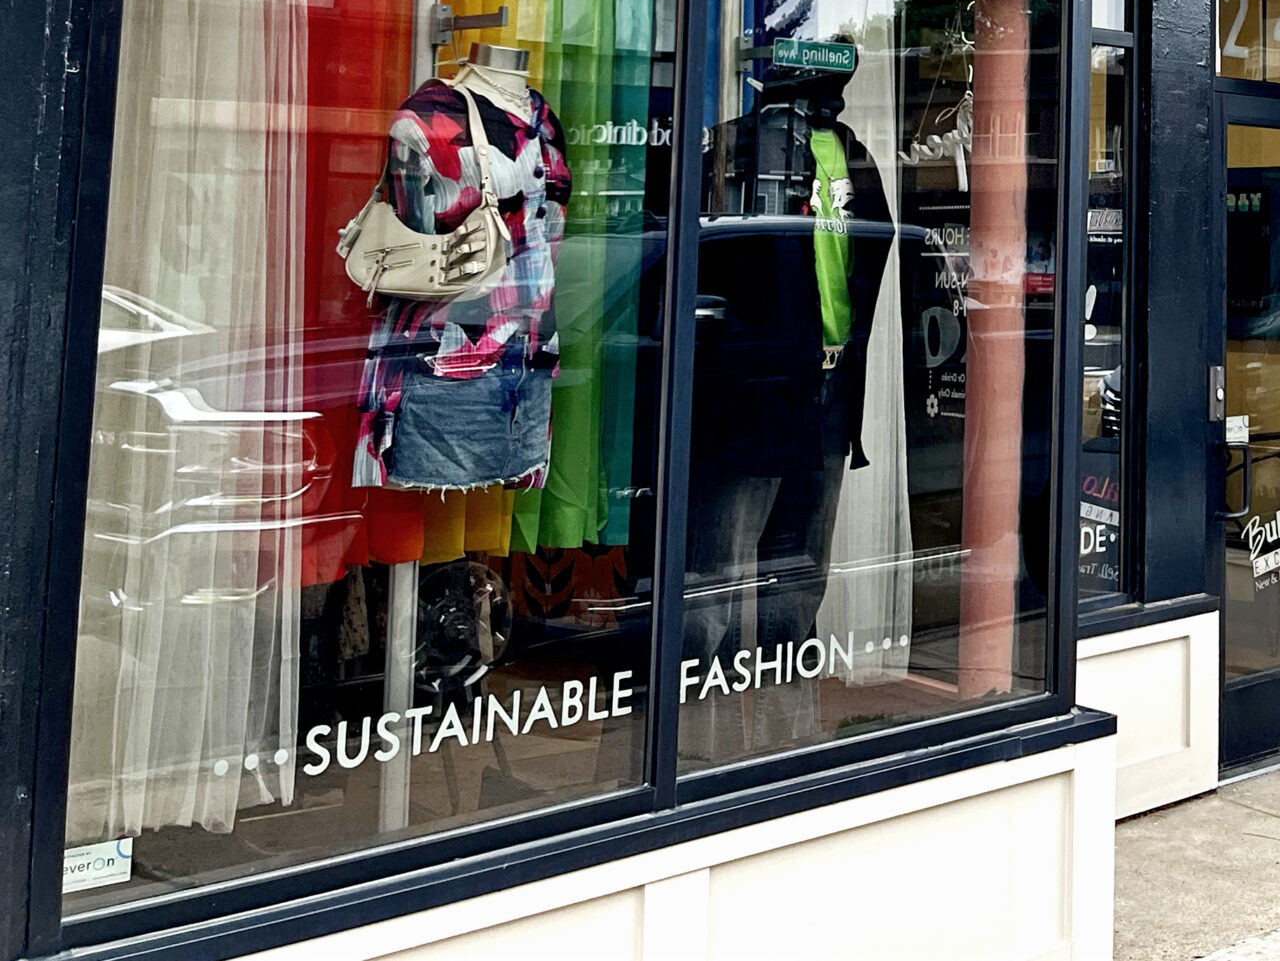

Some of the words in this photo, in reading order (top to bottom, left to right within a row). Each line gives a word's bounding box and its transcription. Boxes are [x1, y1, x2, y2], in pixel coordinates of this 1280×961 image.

[1255, 577, 1270, 592] New
[301, 669, 637, 777] SUSTAINABLE
[678, 630, 857, 705] FASHION
